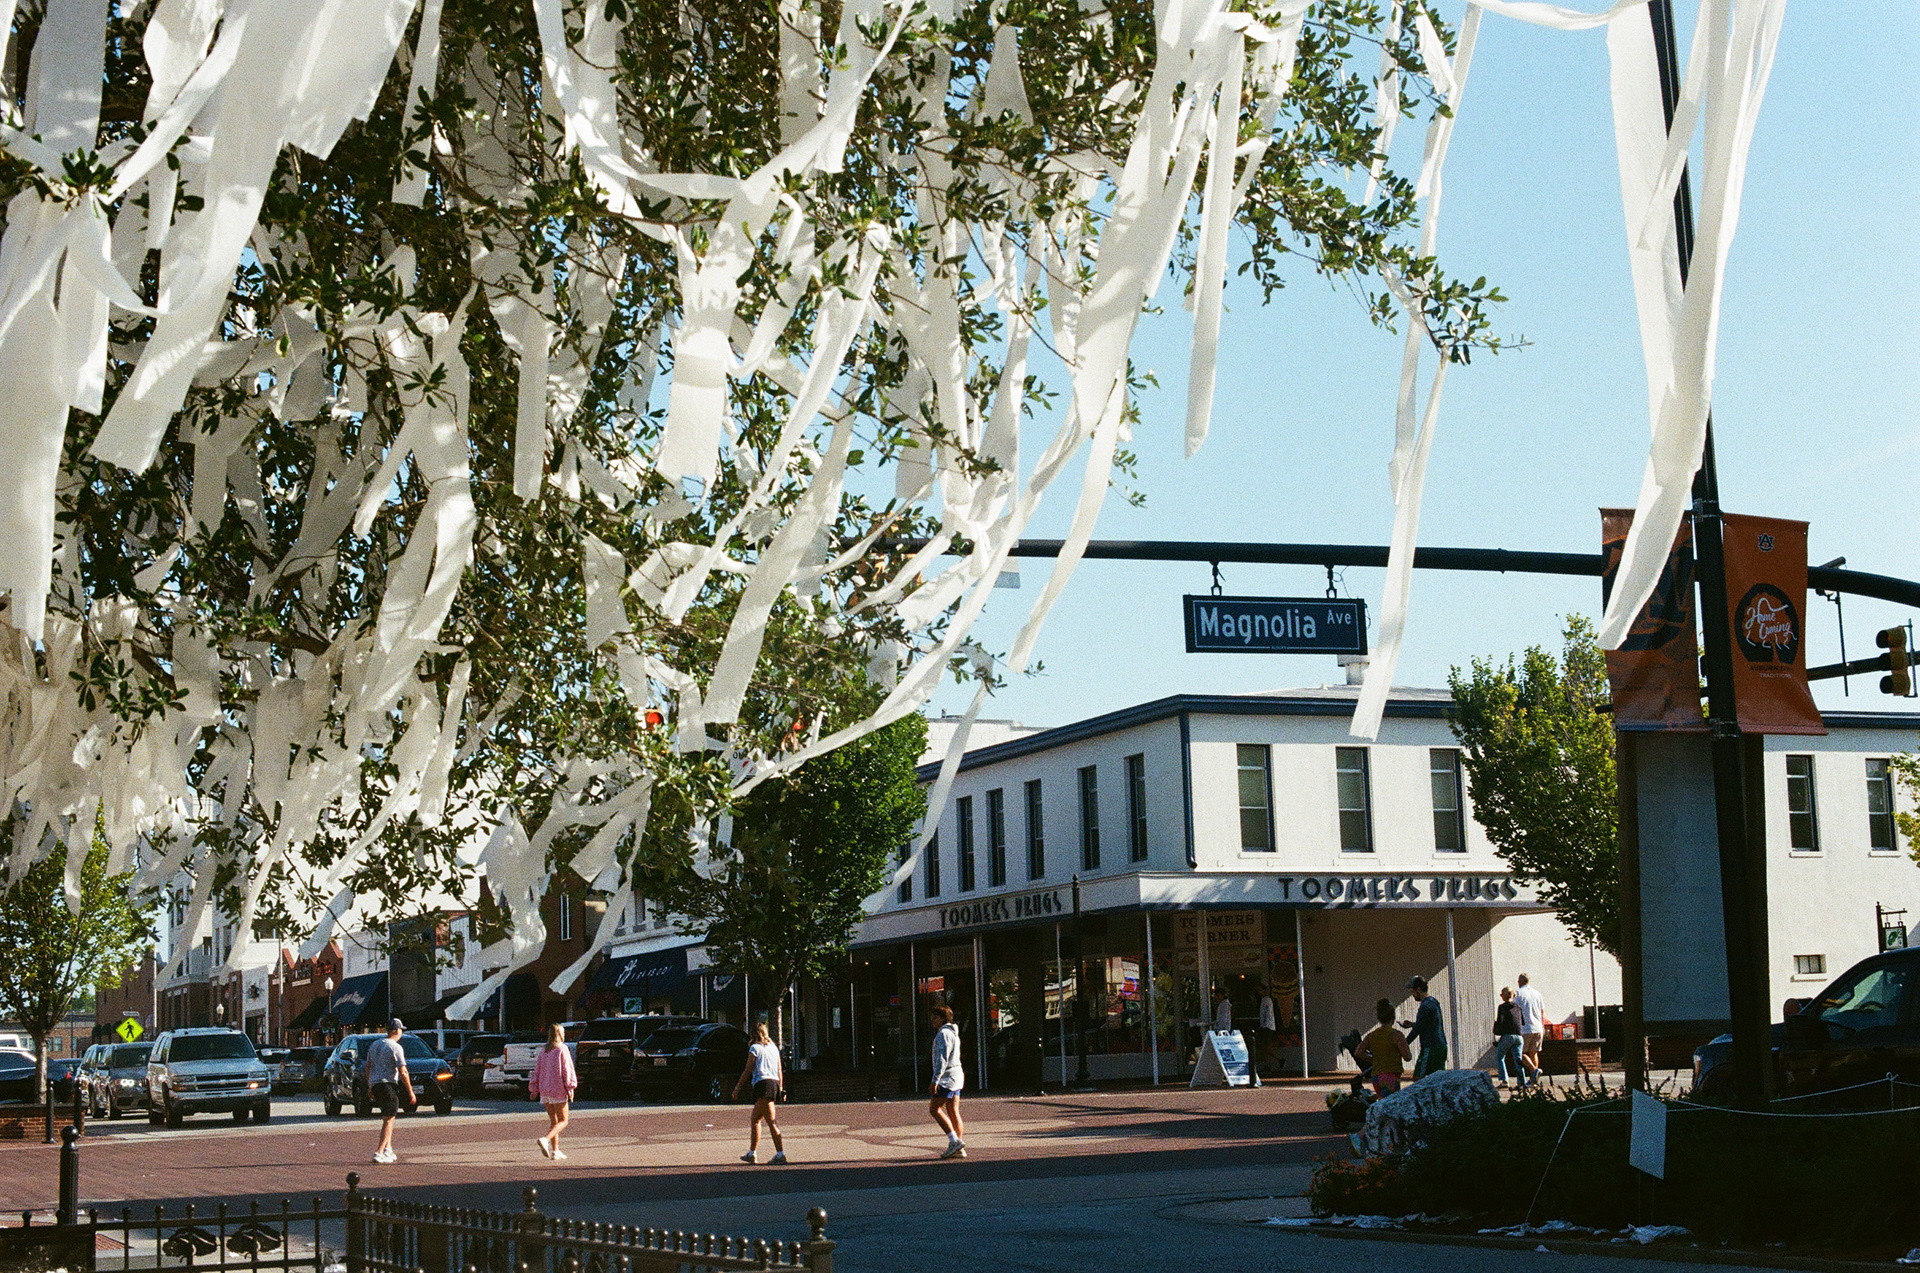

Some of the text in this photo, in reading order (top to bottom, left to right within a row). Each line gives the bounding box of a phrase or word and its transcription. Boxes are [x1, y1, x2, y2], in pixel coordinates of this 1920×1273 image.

[1200, 606, 1352, 644] Magnolia Ave
[1759, 622, 1791, 640] Coming
[1431, 877, 1517, 899] DRUGS
[1015, 891, 1062, 917] DRUGS
[1180, 914, 1255, 928] TOMERS
[1186, 931, 1250, 943] CRNER
